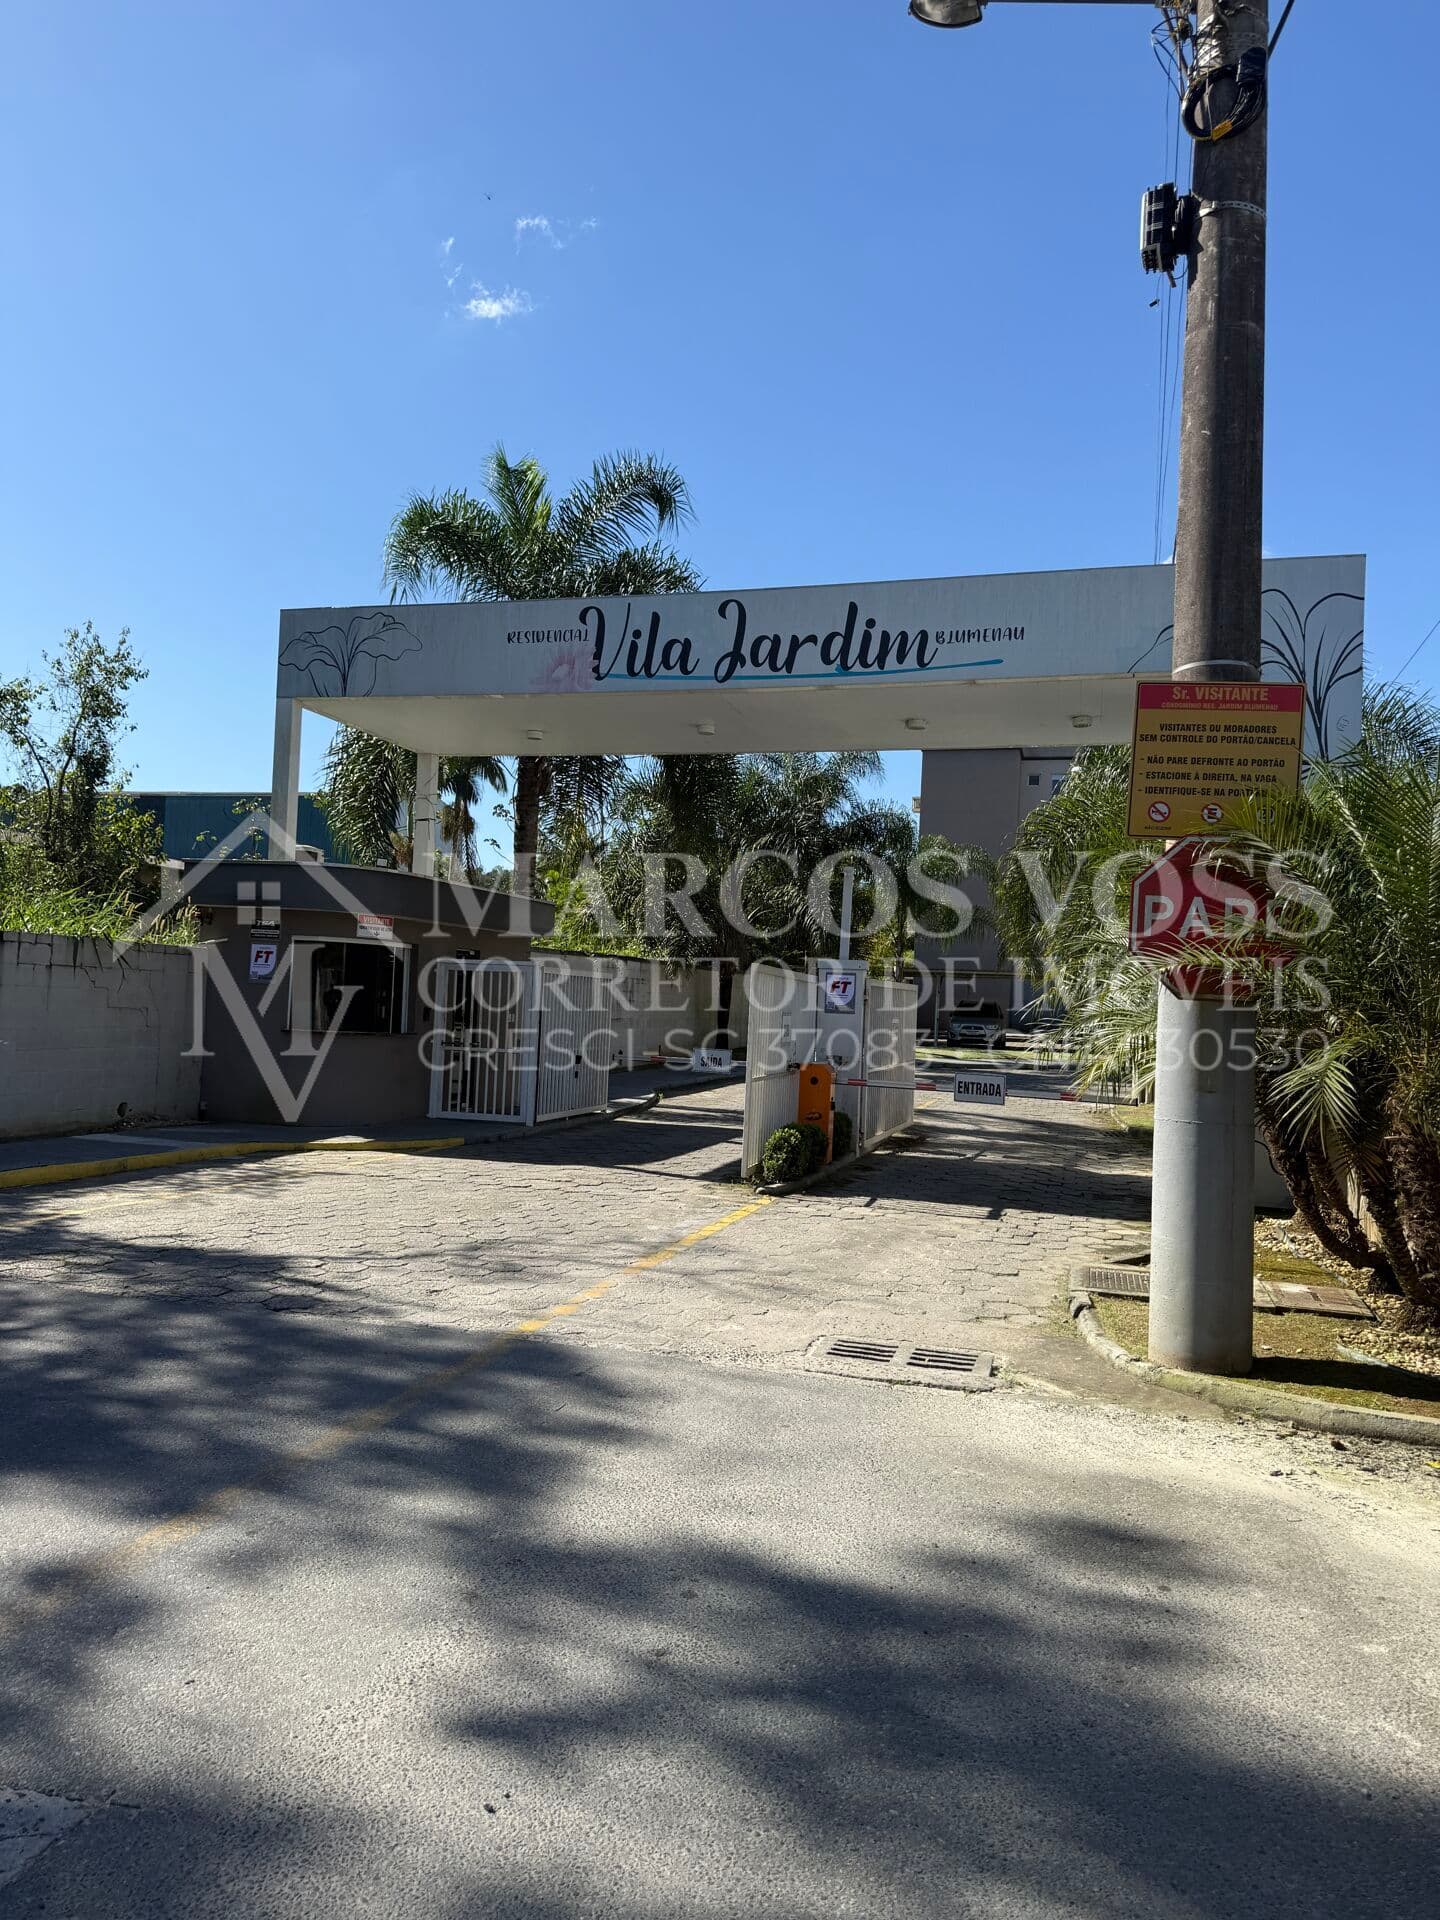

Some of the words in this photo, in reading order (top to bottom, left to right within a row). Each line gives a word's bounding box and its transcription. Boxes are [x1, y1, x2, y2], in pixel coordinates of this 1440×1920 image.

[507, 629, 590, 645] RESIDENCIAL
[579, 602, 699, 681] Vila
[714, 598, 938, 684] Jardim
[935, 625, 1025, 644] BLUMENAU
[1195, 686, 1269, 701] VISITANTE
[1159, 723, 1207, 733] VISITANTES
[1209, 724, 1220, 733] OU
[1223, 724, 1277, 734] MORADORES
[1139, 733, 1157, 743] SEM
[1160, 734, 1204, 743] CONTROLE
[1206, 735, 1218, 743] DO
[1147, 755, 1164, 765] NÃO
[1166, 756, 1188, 765] PARE
[1190, 756, 1234, 766] DEFRONTE
[1236, 758, 1248, 767] AO
[1251, 757, 1285, 768] PORTÃO
[1145, 771, 1192, 781] ESTACIONE
[1240, 773, 1252, 782] NA
[1255, 774, 1277, 783] VAGA
[1144, 786, 1211, 796] IDENTIFIQUE-SE
[1213, 787, 1226, 797] NA
[1144, 895, 1280, 940] PAR
[957, 1080, 1002, 1097] ENTRADA
